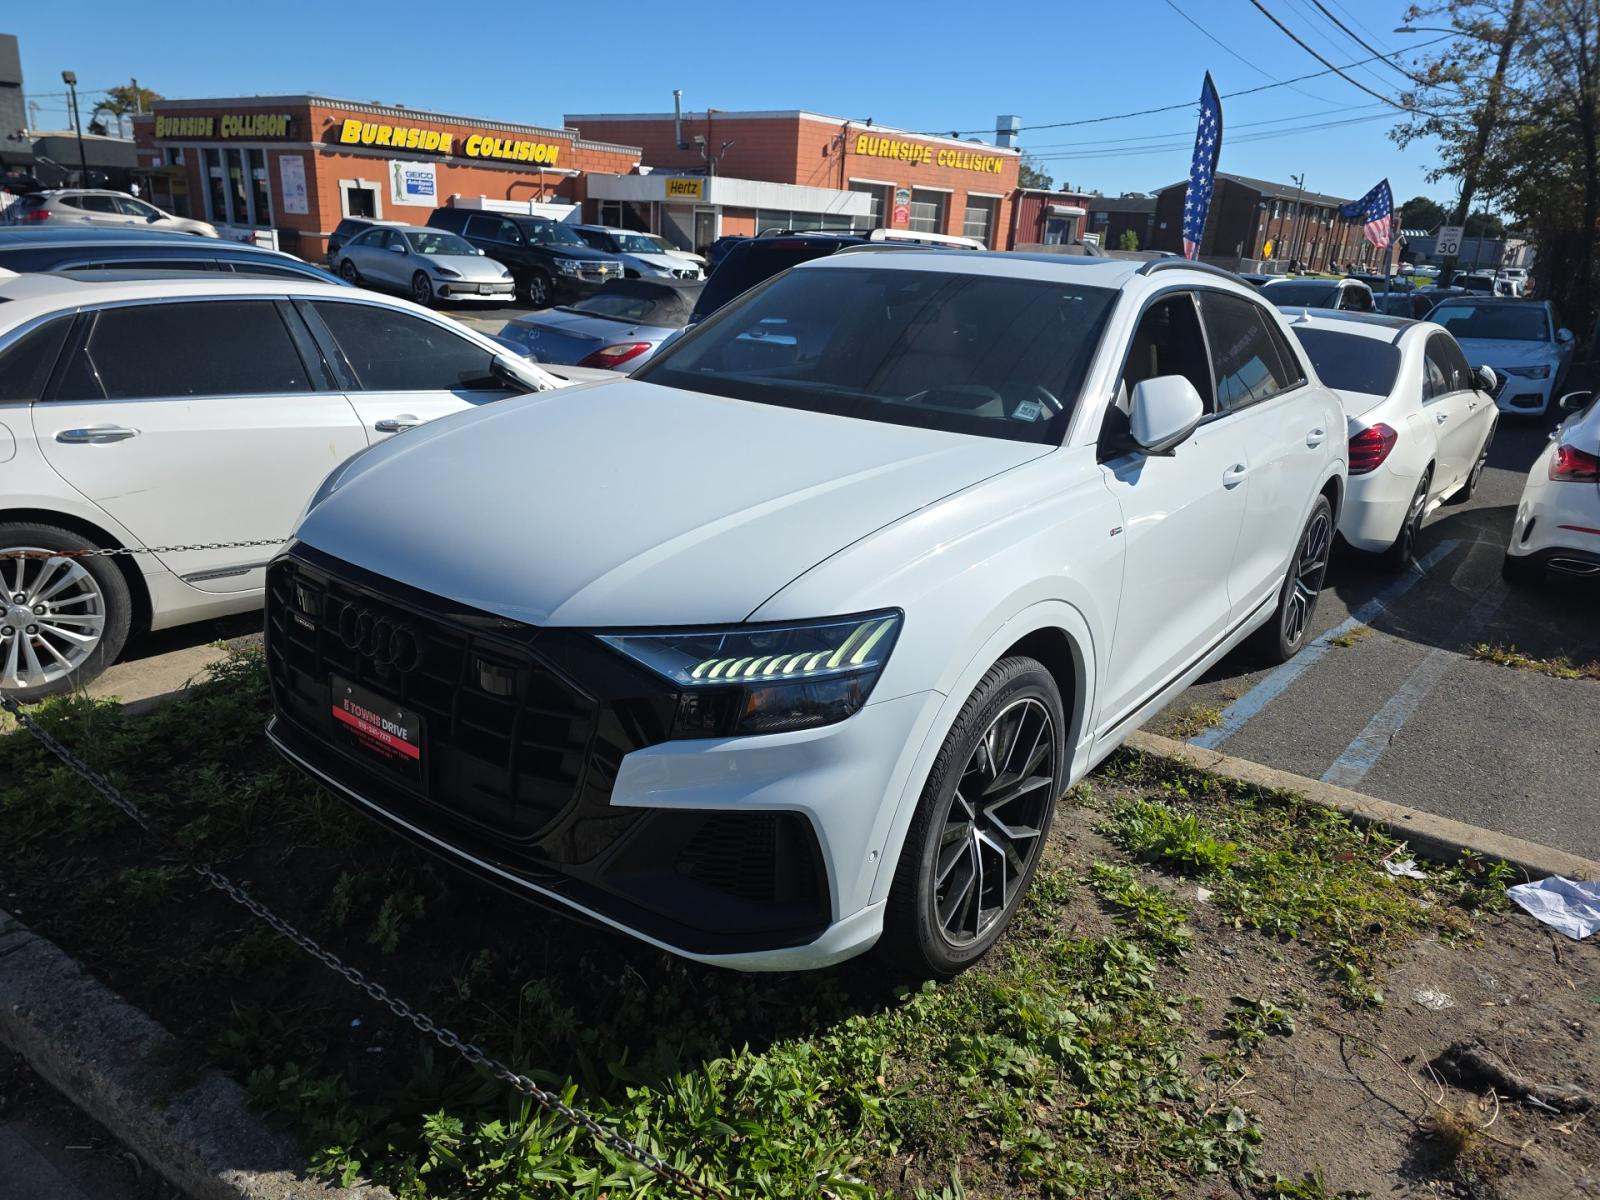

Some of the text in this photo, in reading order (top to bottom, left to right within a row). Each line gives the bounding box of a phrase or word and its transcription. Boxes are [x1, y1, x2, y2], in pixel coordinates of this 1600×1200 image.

[155, 114, 287, 138] BURNSIDE COLLISION
[340, 119, 559, 165] BURNSIDE COLLISION
[855, 134, 1004, 175] BURNSIDE COLLISION
[406, 171, 434, 179] GEICO
[671, 180, 697, 194] Hertz
[1438, 243, 1457, 254] 30
[350, 702, 381, 727] TOWNS
[381, 718, 408, 740] DRIVE
